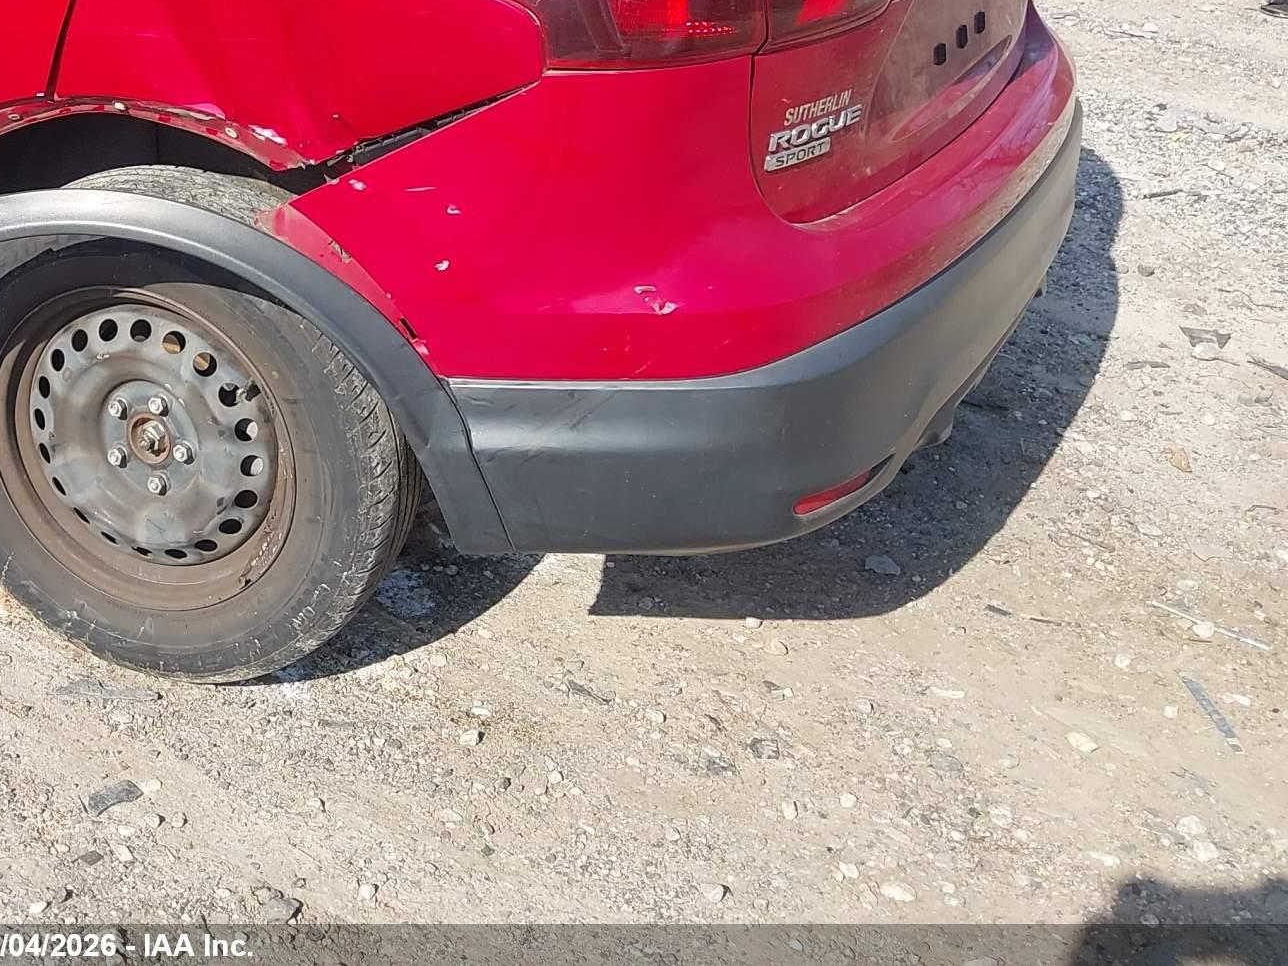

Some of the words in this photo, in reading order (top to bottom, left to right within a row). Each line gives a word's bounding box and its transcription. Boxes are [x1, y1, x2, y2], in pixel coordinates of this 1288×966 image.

[784, 89, 852, 126] SUTHERLIN
[768, 104, 863, 152] ROGUE
[774, 141, 827, 169] SPORT
